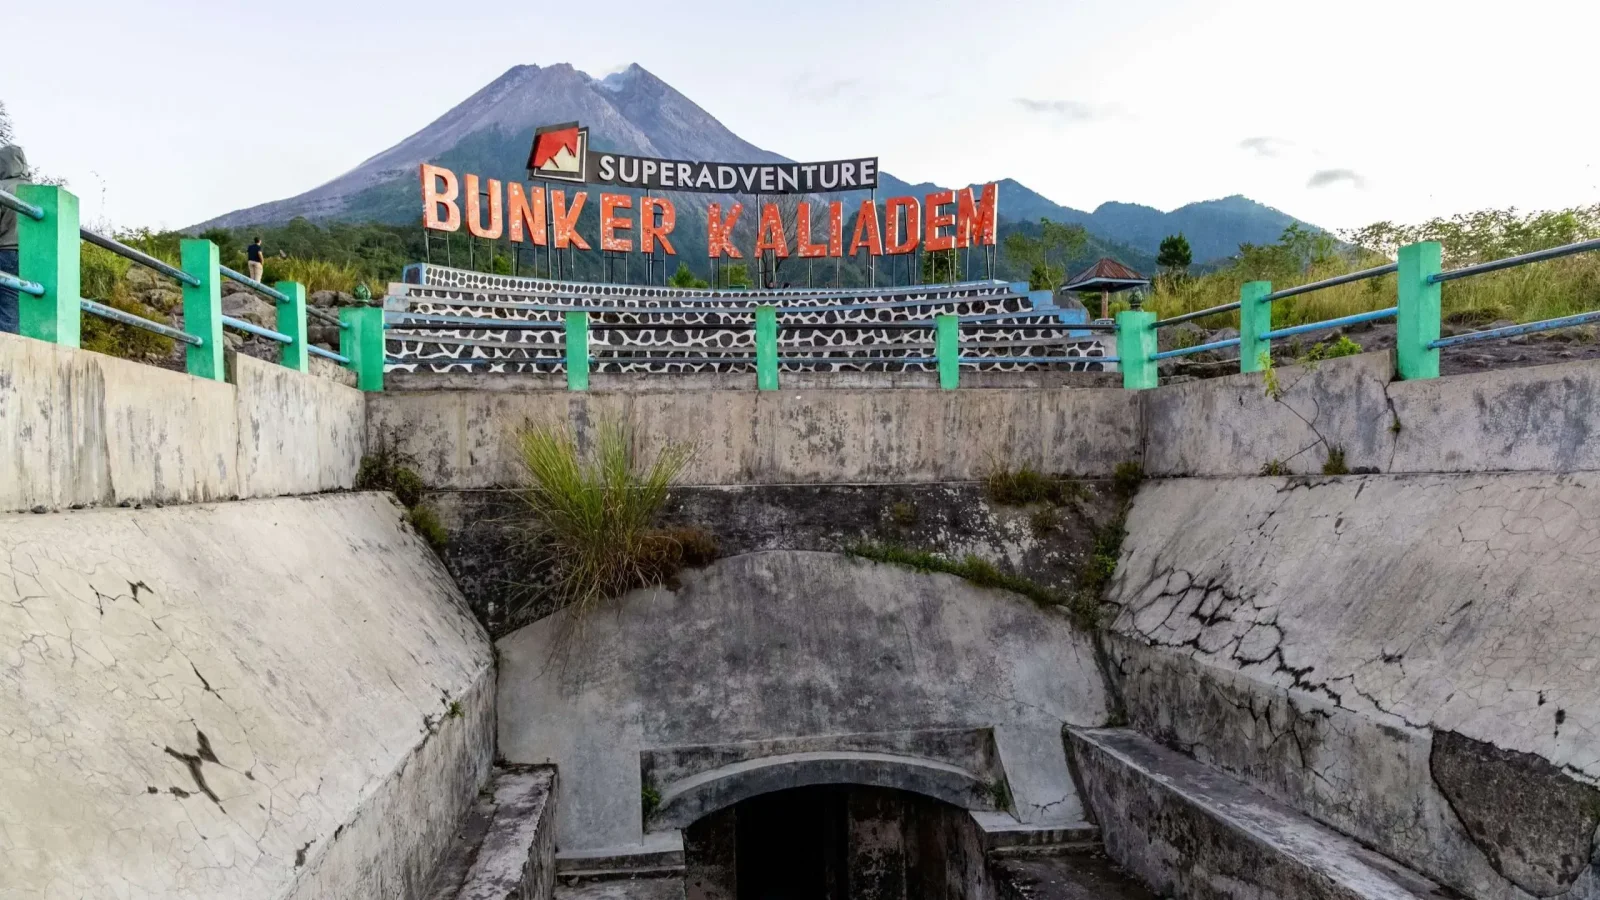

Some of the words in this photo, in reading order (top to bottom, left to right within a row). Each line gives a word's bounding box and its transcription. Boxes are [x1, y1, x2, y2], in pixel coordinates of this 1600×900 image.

[600, 155, 875, 191] SUPERADVENTURE
[420, 163, 676, 256] BUNKER
[708, 183, 998, 258] KALIADEM
